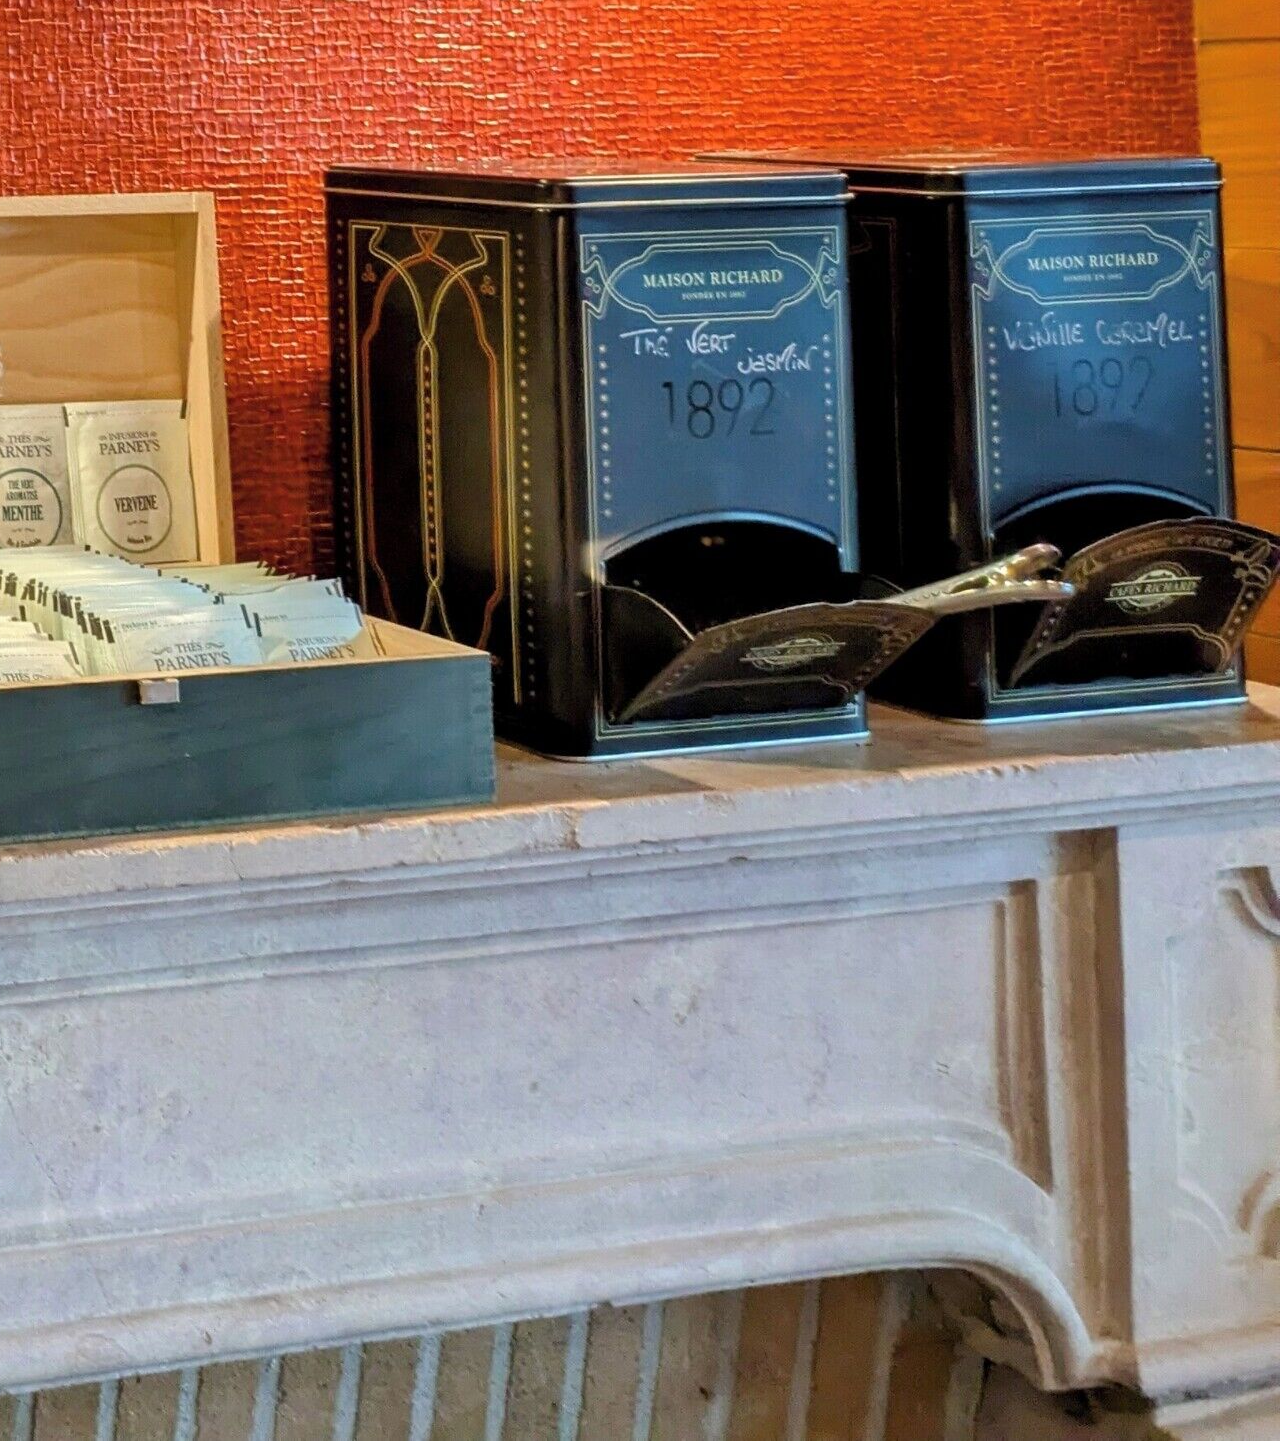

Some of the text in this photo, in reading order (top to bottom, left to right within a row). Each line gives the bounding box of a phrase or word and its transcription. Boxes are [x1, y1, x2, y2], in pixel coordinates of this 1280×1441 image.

[1027, 251, 1159, 271] MAISON RICHARD
[643, 269, 784, 289] MAISON RICHARD
[661, 377, 777, 440] 1892
[99, 439, 161, 456] PARNEY'S
[2, 504, 44, 522] MENTHE
[114, 495, 159, 513] VERVEINE
[154, 651, 232, 673] PARNEY'S
[290, 644, 356, 663] PARNEY'S
